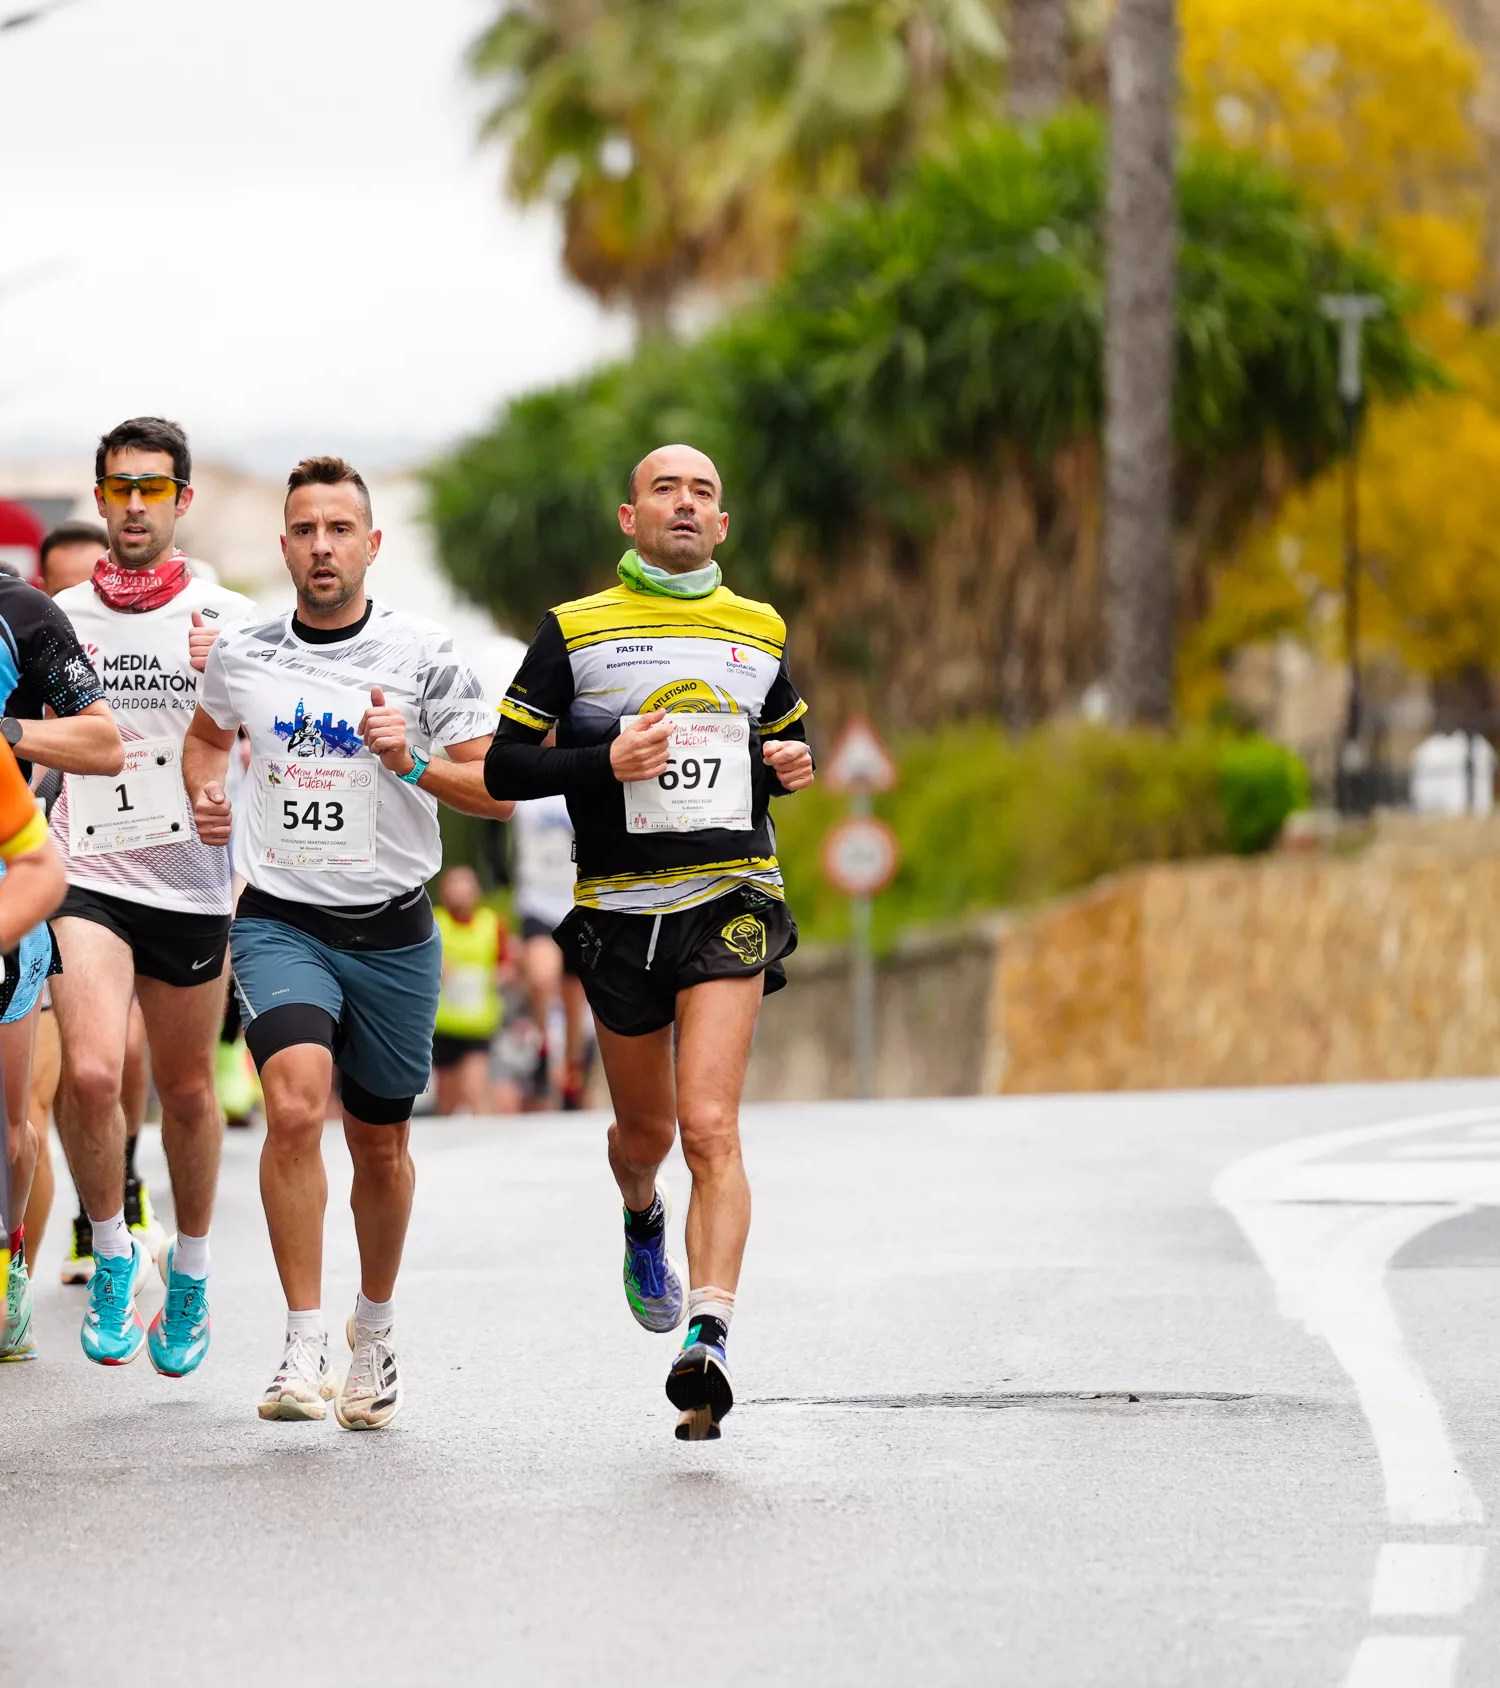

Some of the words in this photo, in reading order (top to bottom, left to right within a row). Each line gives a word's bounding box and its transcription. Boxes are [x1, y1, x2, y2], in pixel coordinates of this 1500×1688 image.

[616, 645, 653, 654] FASTER
[103, 655, 162, 671] MEDIA
[606, 659, 671, 669] #teamperezcampos
[726, 661, 757, 672] Diputación
[103, 671, 197, 692] MARATÓN
[106, 696, 166, 710] CÓRDOBA
[172, 698, 197, 711] 2023
[653, 682, 697, 711] ATLETISMO
[675, 735, 711, 746] LUCENA
[122, 761, 141, 771] ENA
[658, 758, 722, 790] 697
[298, 778, 336, 790] LUCENA
[115, 784, 134, 811] 1
[283, 800, 344, 832] 543
